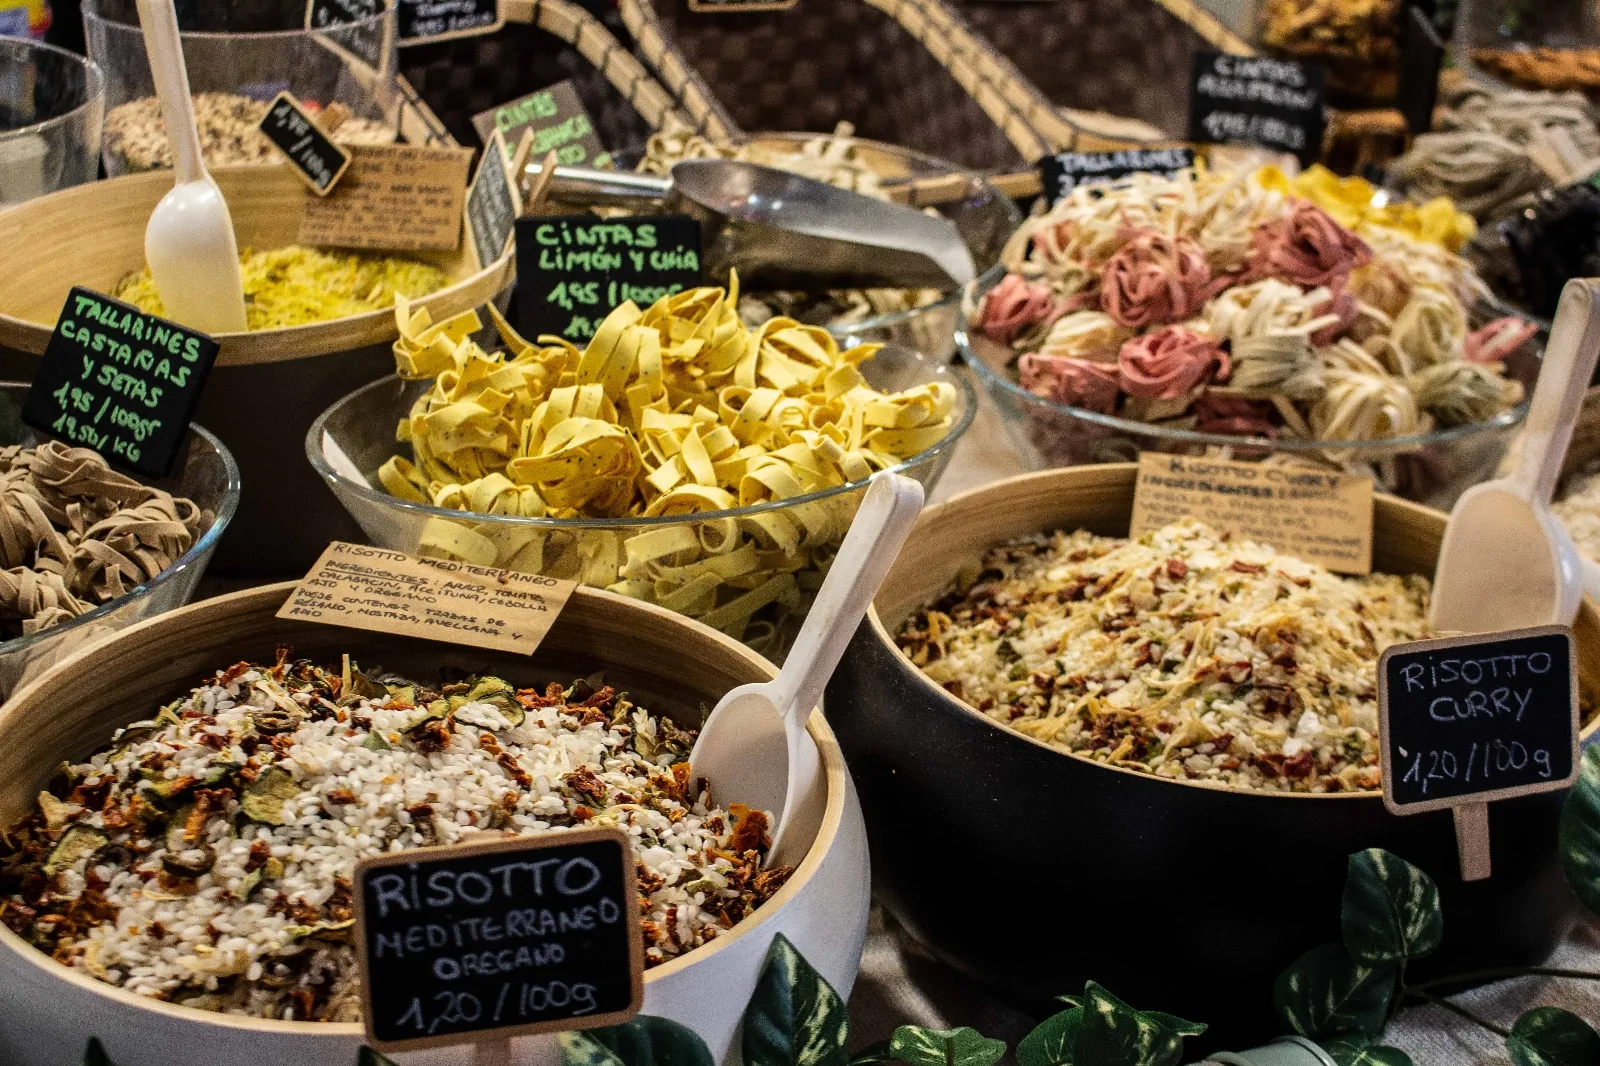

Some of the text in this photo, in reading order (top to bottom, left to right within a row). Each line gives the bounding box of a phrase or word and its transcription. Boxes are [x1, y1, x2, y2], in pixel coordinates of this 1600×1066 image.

[535, 221, 658, 248] CINTAS
[75, 295, 200, 362] TALLARINES
[60, 320, 191, 388] CASTAÑAS
[97, 364, 163, 407] SETAS
[333, 544, 407, 562] RISOTTO
[307, 578, 338, 588] AJO
[486, 618, 506, 627] DE
[1399, 652, 1551, 693] RISOTTO
[1429, 686, 1532, 722] CURRY
[368, 857, 601, 917] RISOTTO
[375, 896, 620, 958] MEDITERRANEO
[432, 942, 566, 980] OREGANO
